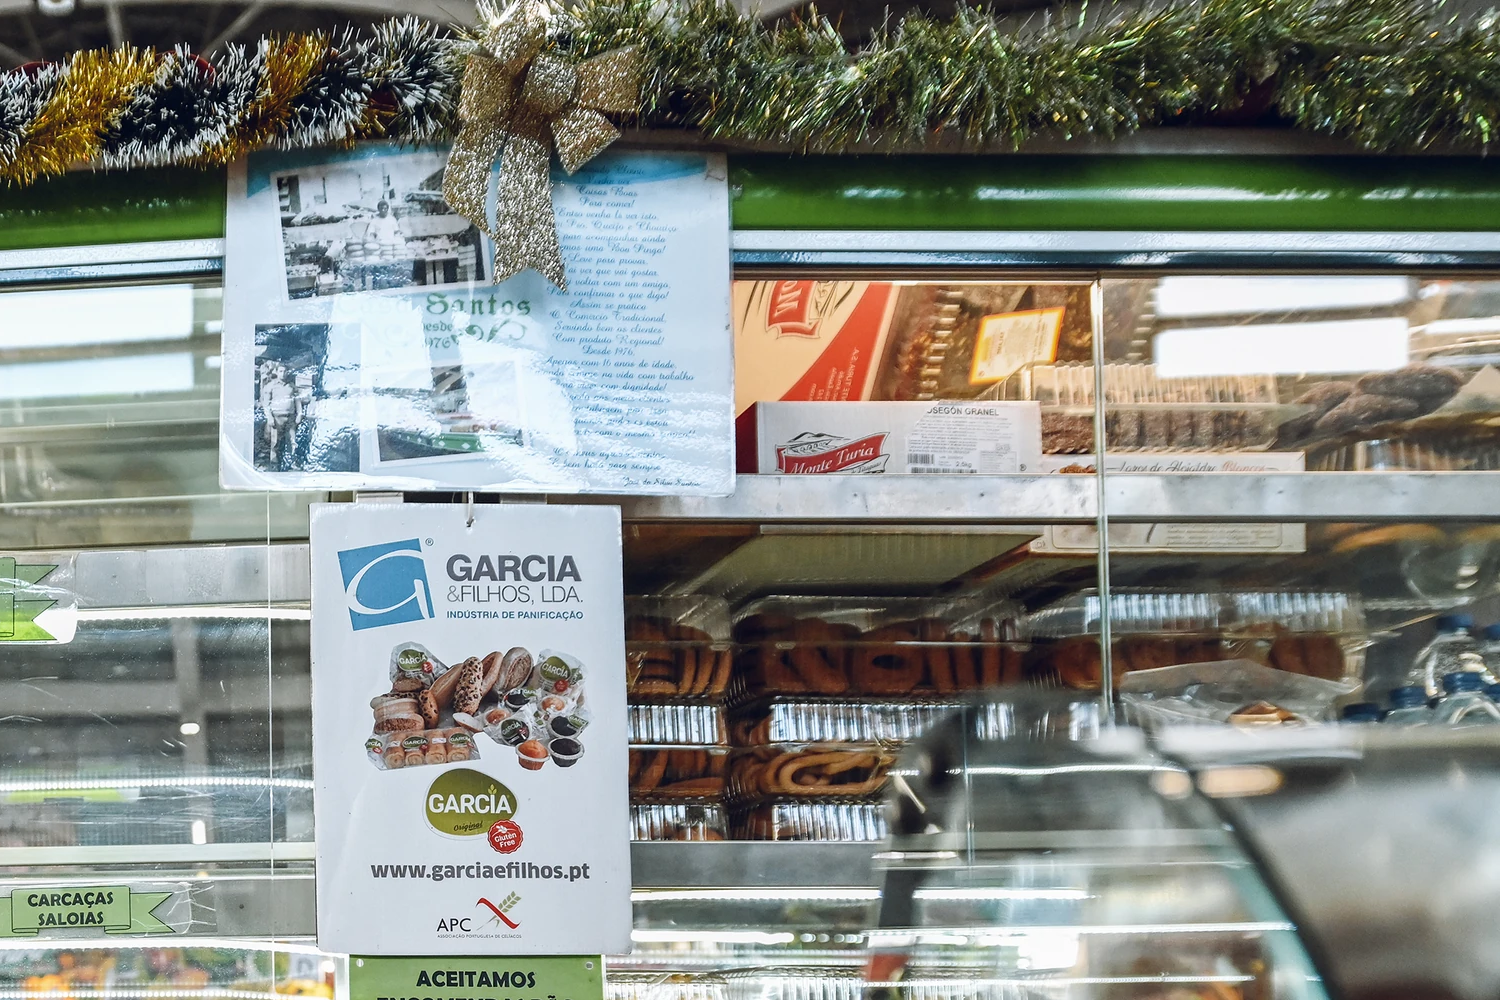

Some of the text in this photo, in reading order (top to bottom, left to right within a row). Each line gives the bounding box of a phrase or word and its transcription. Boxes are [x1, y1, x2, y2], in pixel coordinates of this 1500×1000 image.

[579, 197, 602, 207] Para
[596, 268, 611, 278] que
[573, 288, 615, 299] confirmar
[628, 292, 644, 301] que
[426, 292, 531, 316] Santos
[424, 336, 451, 349] 976
[964, 407, 1000, 417] GRANEL
[790, 458, 833, 473] Monte
[835, 443, 874, 465] Turia
[446, 553, 582, 583] GARCIA
[446, 584, 584, 605] &FILHOS, LDA.
[446, 609, 584, 621] INDÚSTRIA DE PANIFICAÇÃO
[453, 820, 484, 832] Original
[494, 831, 518, 843] Gluten
[499, 839, 516, 848] Free
[370, 861, 591, 882] www.garciaefilhos.pt
[28, 892, 114, 908] CARCAÇAS
[38, 911, 104, 926] SALOIAS
[436, 917, 472, 932] APC
[416, 970, 536, 989] ACEITAMOS
